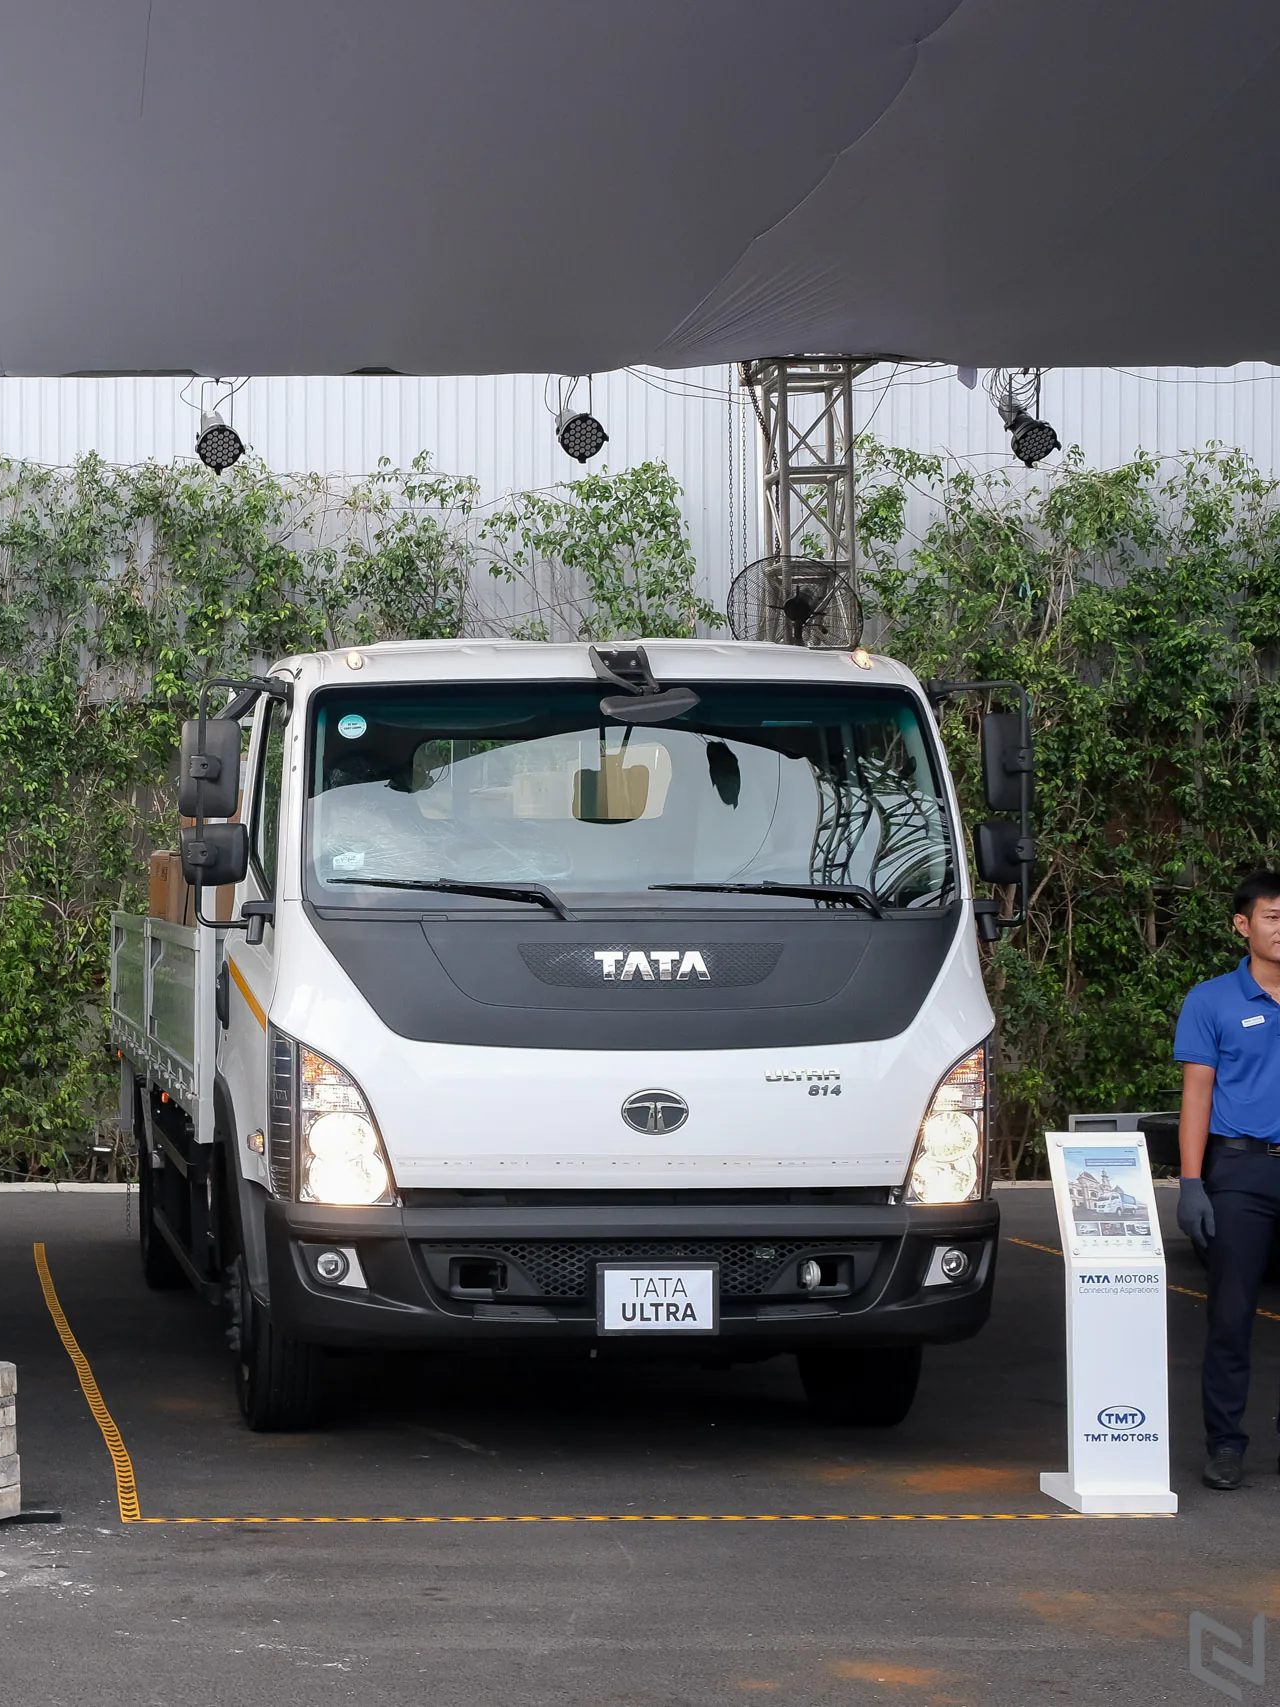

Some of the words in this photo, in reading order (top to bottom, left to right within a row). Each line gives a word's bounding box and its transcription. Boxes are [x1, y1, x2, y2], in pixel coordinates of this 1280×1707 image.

[593, 951, 711, 980] TATA
[764, 1067, 841, 1082] ULTRA
[807, 1084, 842, 1097] 814
[1079, 1274, 1111, 1284] TATA
[1114, 1274, 1160, 1284] MOTORS
[629, 1277, 688, 1298] TATA
[1078, 1286, 1119, 1295] Connecting
[1120, 1286, 1160, 1295] Aspirations
[621, 1302, 698, 1322] ULTRA
[1104, 1413, 1138, 1424] TMT
[1083, 1433, 1108, 1442] TMT
[1110, 1433, 1159, 1442] MOTORS
